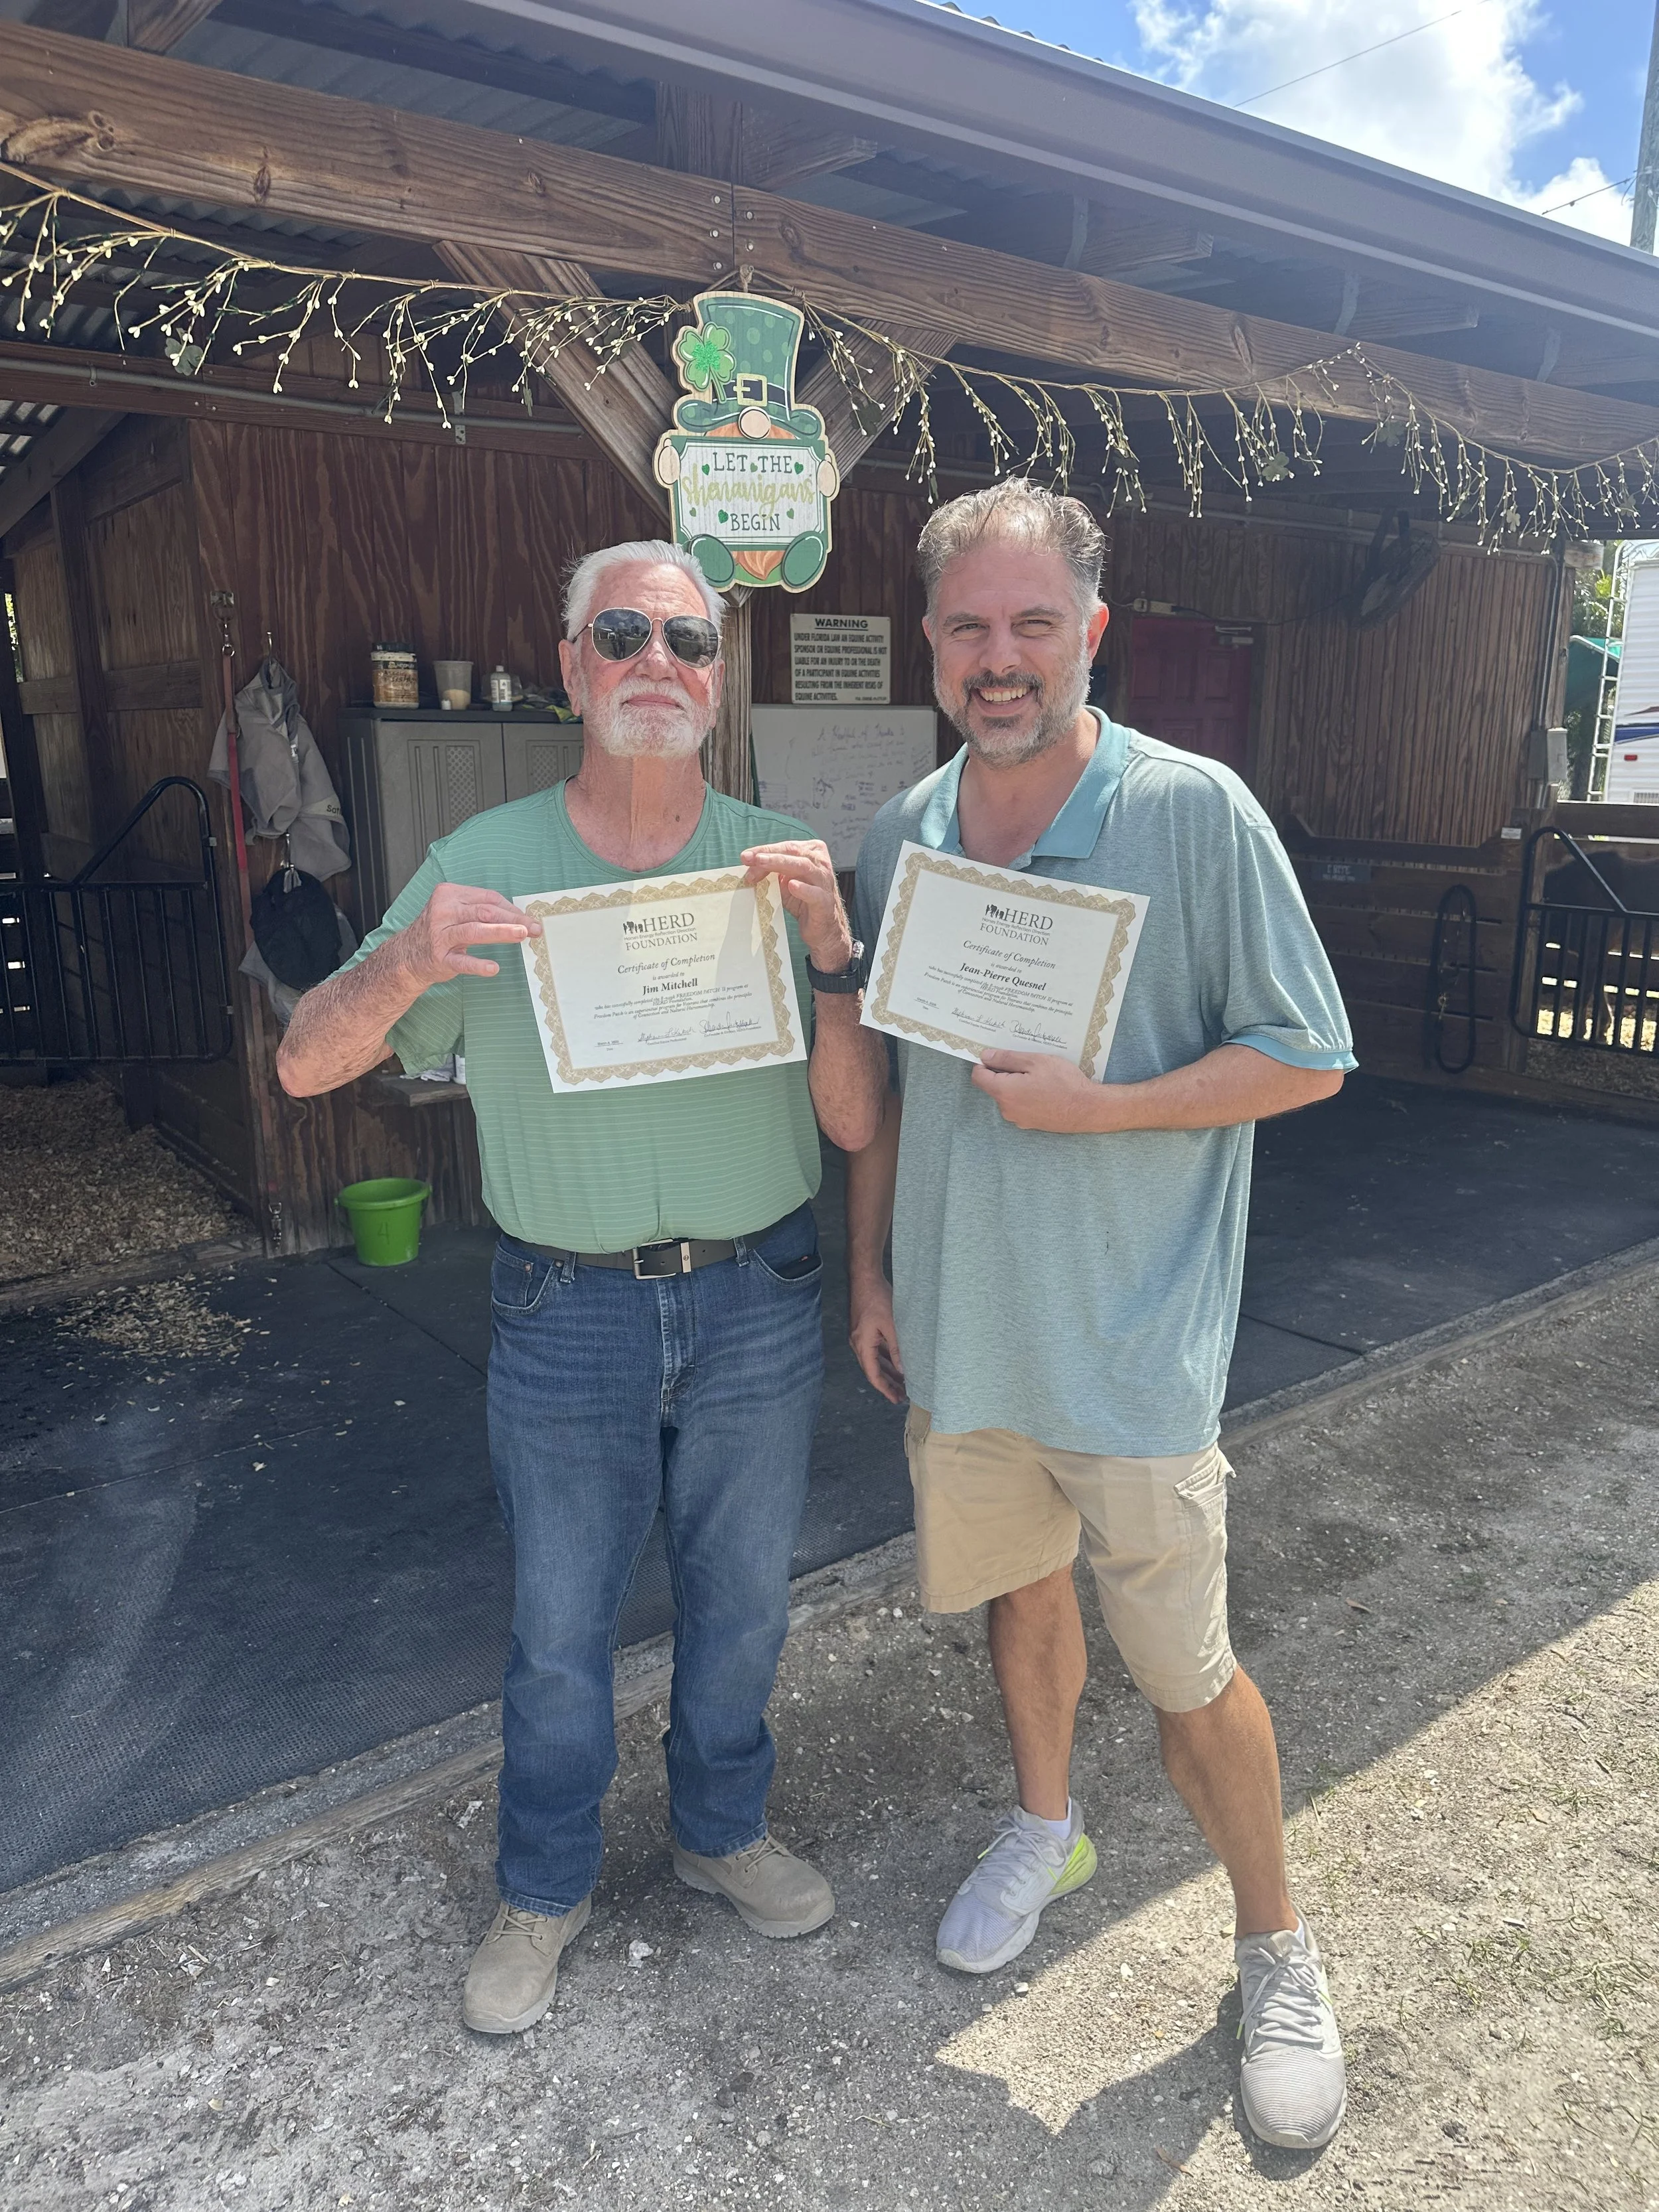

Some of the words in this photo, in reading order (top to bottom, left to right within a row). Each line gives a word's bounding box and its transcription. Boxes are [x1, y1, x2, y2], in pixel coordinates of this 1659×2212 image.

[713, 452, 748, 472] LET
[758, 455, 792, 473] THE
[682, 463, 815, 520] shenanigans
[730, 514, 780, 531] BEGIN
[815, 618, 869, 628] WARNING
[794, 632, 810, 641] UNDER
[811, 633, 830, 642] FLORIDA
[642, 913, 695, 932] HERD
[1003, 908, 1053, 930] HERD
[626, 933, 697, 950] FOUNDATION
[979, 922, 1049, 946] FOUNDATION
[618, 962, 659, 974] Certificate
[661, 958, 670, 970] of
[671, 954, 715, 967] Completion
[964, 940, 1003, 957] Certificate
[1003, 952, 1014, 962] of
[1013, 953, 1056, 969] Completion
[657, 972, 679, 980] awarded
[960, 962, 1011, 982] Jean-Pierre
[1012, 976, 1046, 991] Quesnel
[642, 985, 659, 995] Jim
[662, 978, 698, 992] Mitchell
[1005, 987, 1030, 996] FREEDOM
